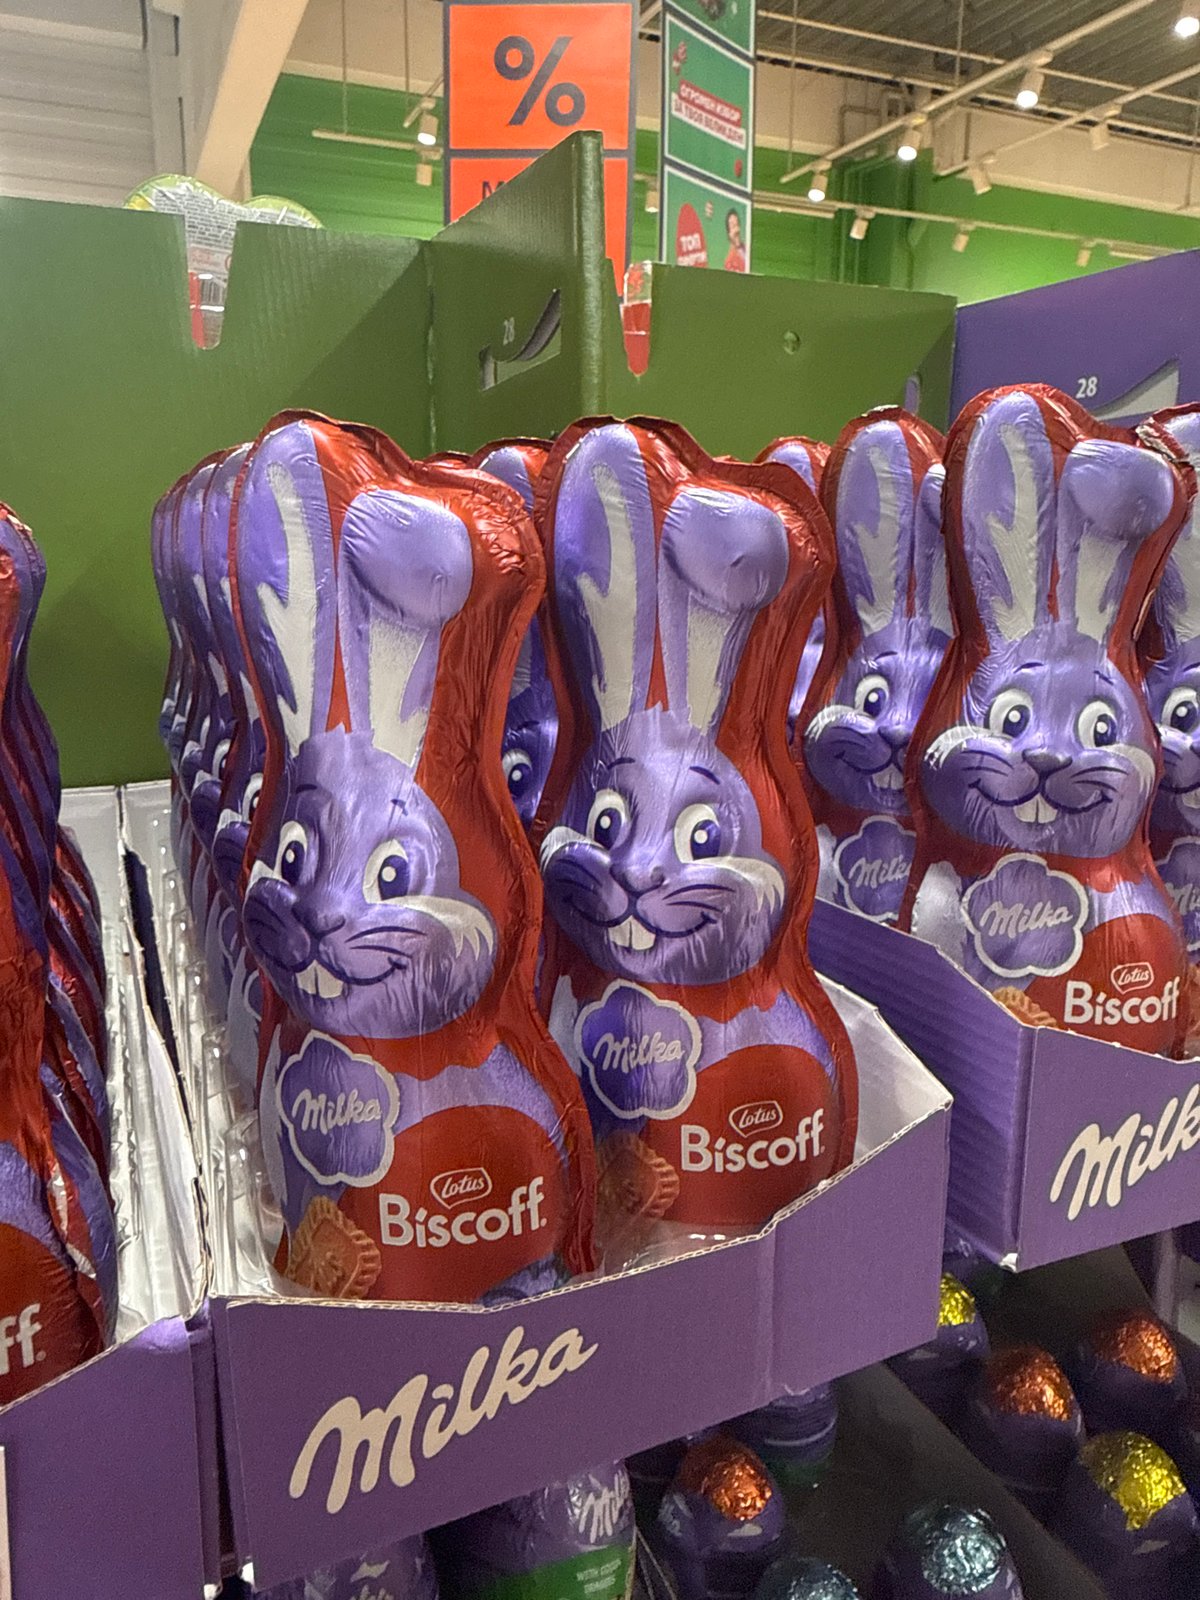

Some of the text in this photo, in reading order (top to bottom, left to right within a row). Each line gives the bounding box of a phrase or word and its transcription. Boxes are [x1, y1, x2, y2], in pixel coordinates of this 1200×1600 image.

[494, 35, 586, 127] %
[1075, 376, 1098, 399] 28
[979, 900, 1074, 938] Milka
[1117, 968, 1150, 985] Lotus
[593, 1032, 685, 1073] Milka
[292, 1089, 382, 1135] Milka
[738, 1107, 777, 1129] Lotus
[441, 1174, 485, 1199] Lotus
[289, 1326, 598, 1514] Milka
